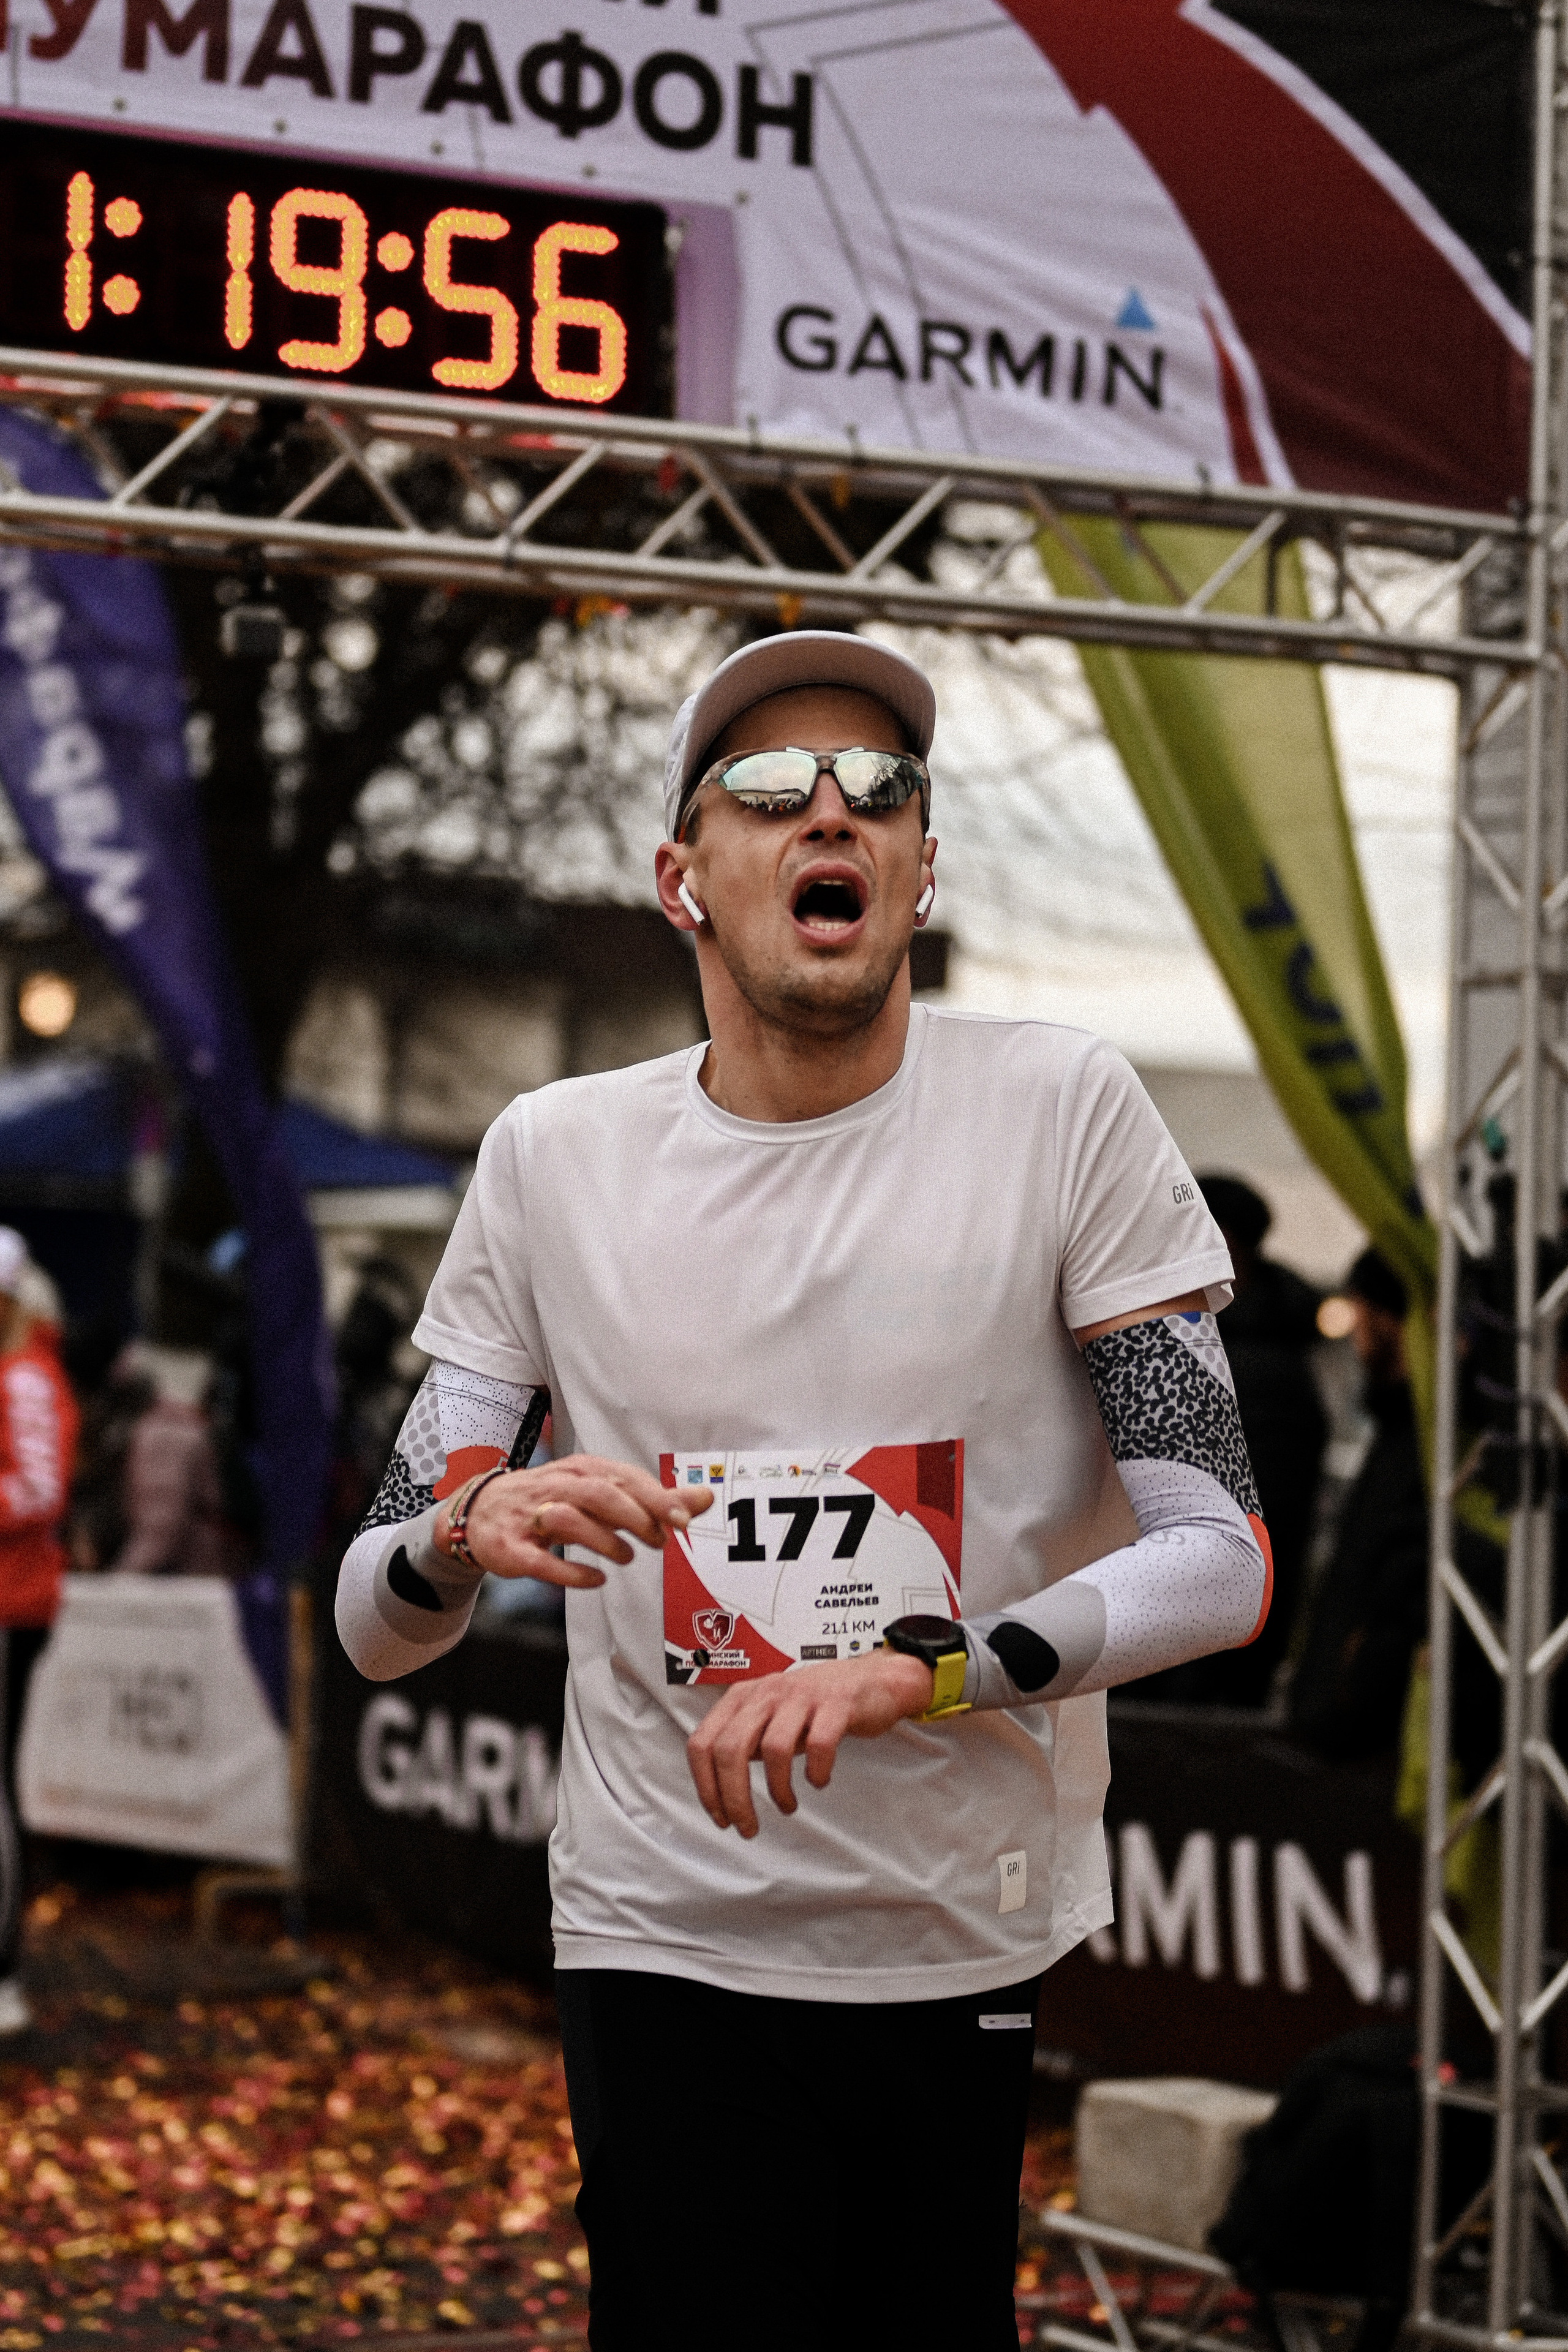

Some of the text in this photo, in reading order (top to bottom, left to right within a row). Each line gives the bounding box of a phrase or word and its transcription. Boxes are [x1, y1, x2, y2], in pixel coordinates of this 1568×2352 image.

[0, 0, 813, 167] УМАРАФОН
[775, 304, 1167, 413] GARMIN
[728, 1494, 875, 1562] 177
[815, 1596, 879, 1608] САВЕЛЬЕВ
[1088, 1820, 1383, 2004] MIN
